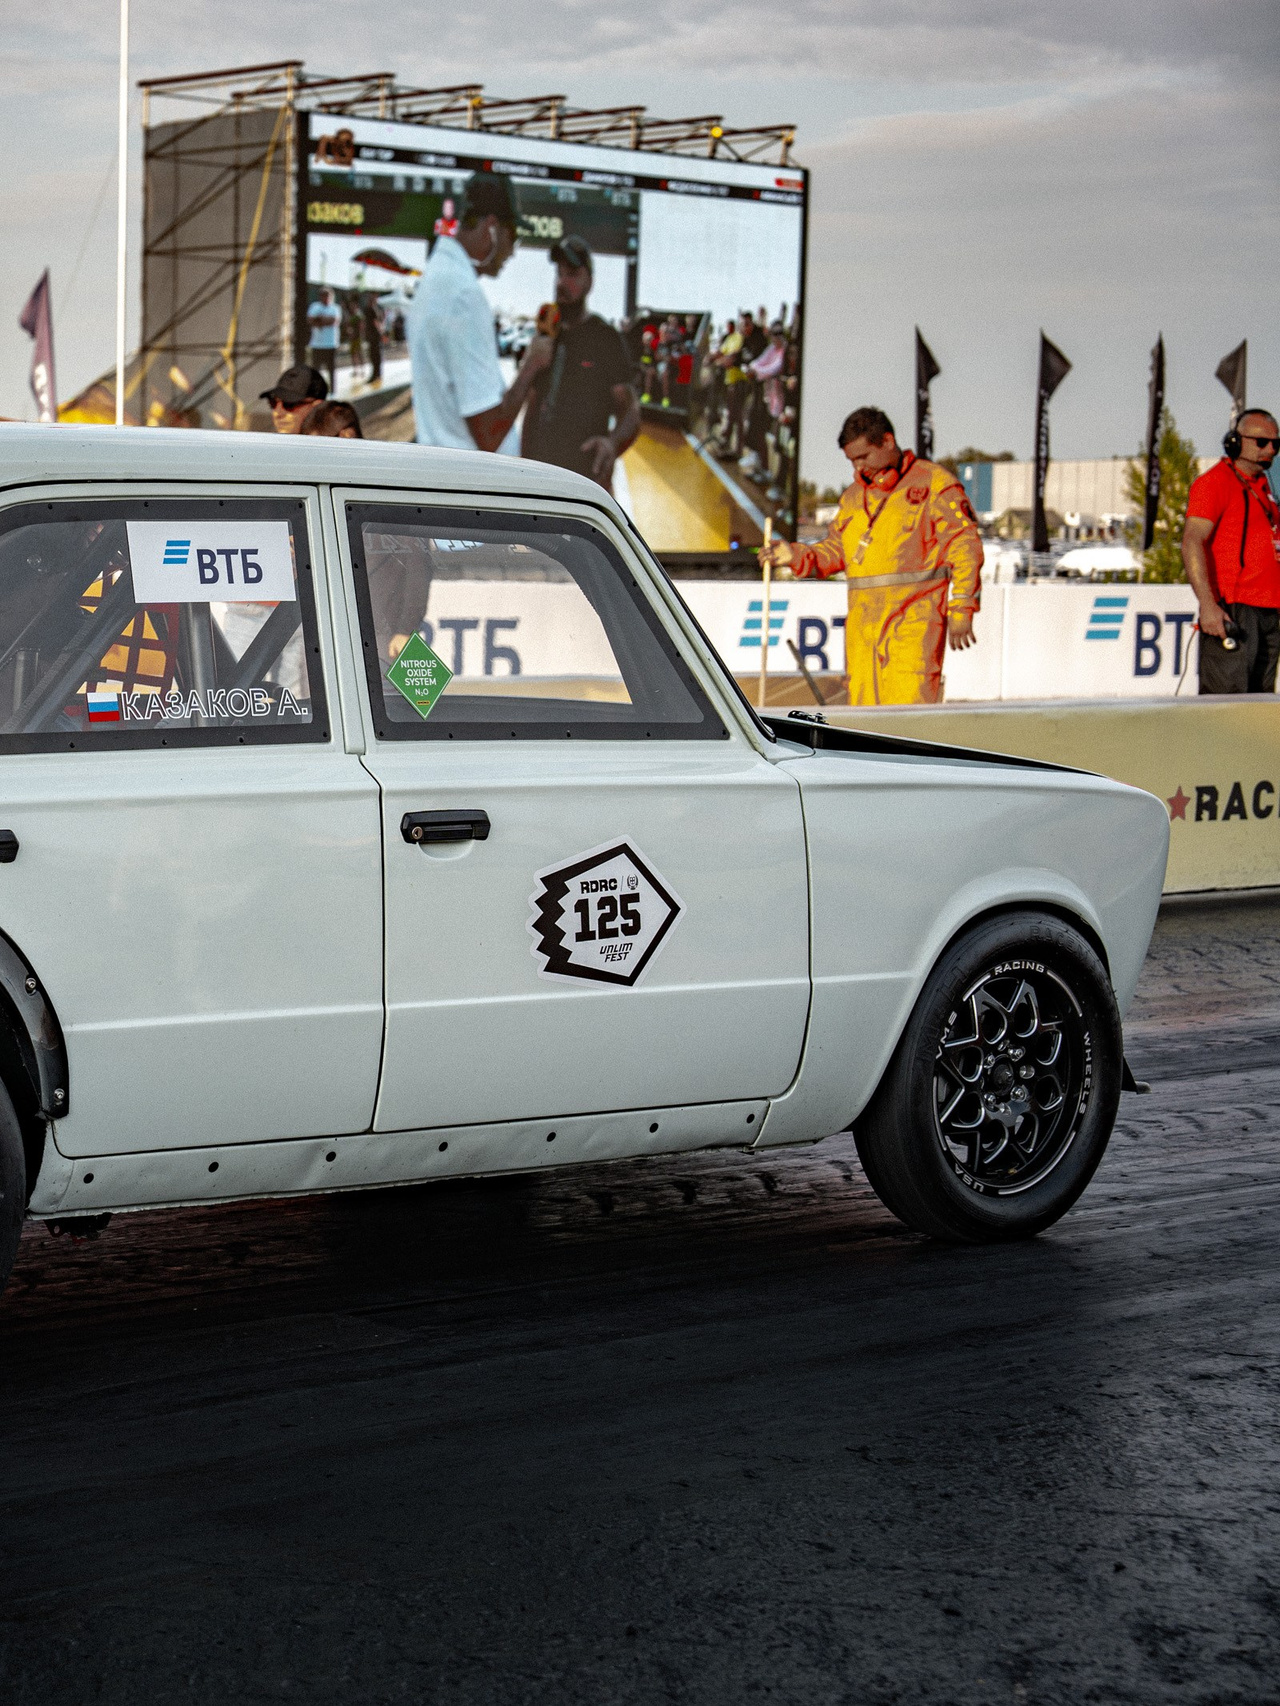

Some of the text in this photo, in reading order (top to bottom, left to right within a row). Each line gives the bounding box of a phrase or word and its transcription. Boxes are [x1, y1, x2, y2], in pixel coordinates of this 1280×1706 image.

[196, 548, 264, 585] ВТБ
[1134, 612, 1199, 676] ВТ
[400, 659, 437, 668] NITROUS
[406, 668, 433, 677] OXIDE
[404, 677, 437, 686] SYSTEM
[121, 687, 308, 720] КАЗАКОВ А.
[1195, 780, 1280, 822] RAC
[580, 878, 618, 894] RDRC
[574, 892, 641, 943] 125
[604, 951, 629, 963] FEST
[994, 960, 1045, 977] RACING
[1079, 1031, 1093, 1115] WHEELS
[954, 1162, 985, 1193] USA
